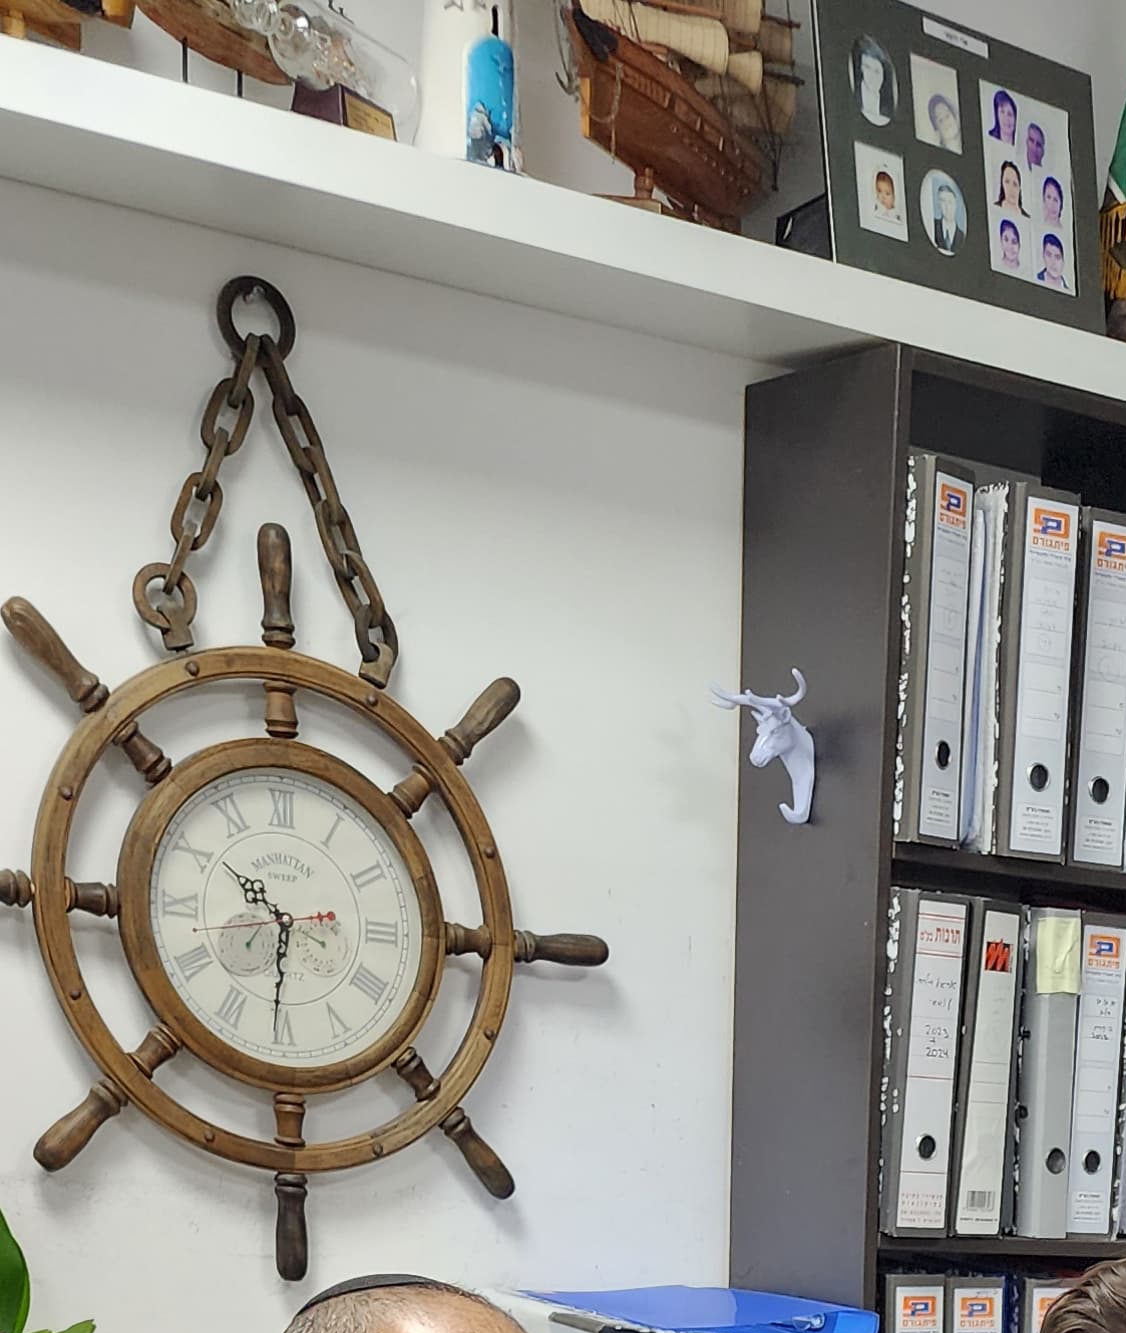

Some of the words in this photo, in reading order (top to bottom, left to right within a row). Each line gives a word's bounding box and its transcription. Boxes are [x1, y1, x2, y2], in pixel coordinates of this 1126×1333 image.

[1031, 536, 1070, 552] פיתגורס
[211, 792, 250, 839] XI
[268, 788, 296, 829] XII
[171, 831, 214, 875] X
[250, 851, 315, 880] MANHATTAN
[925, 1046, 949, 1059] 2024
[902, 1319, 937, 1328] פיתגורס
[959, 1320, 995, 1328] פיתגורס
